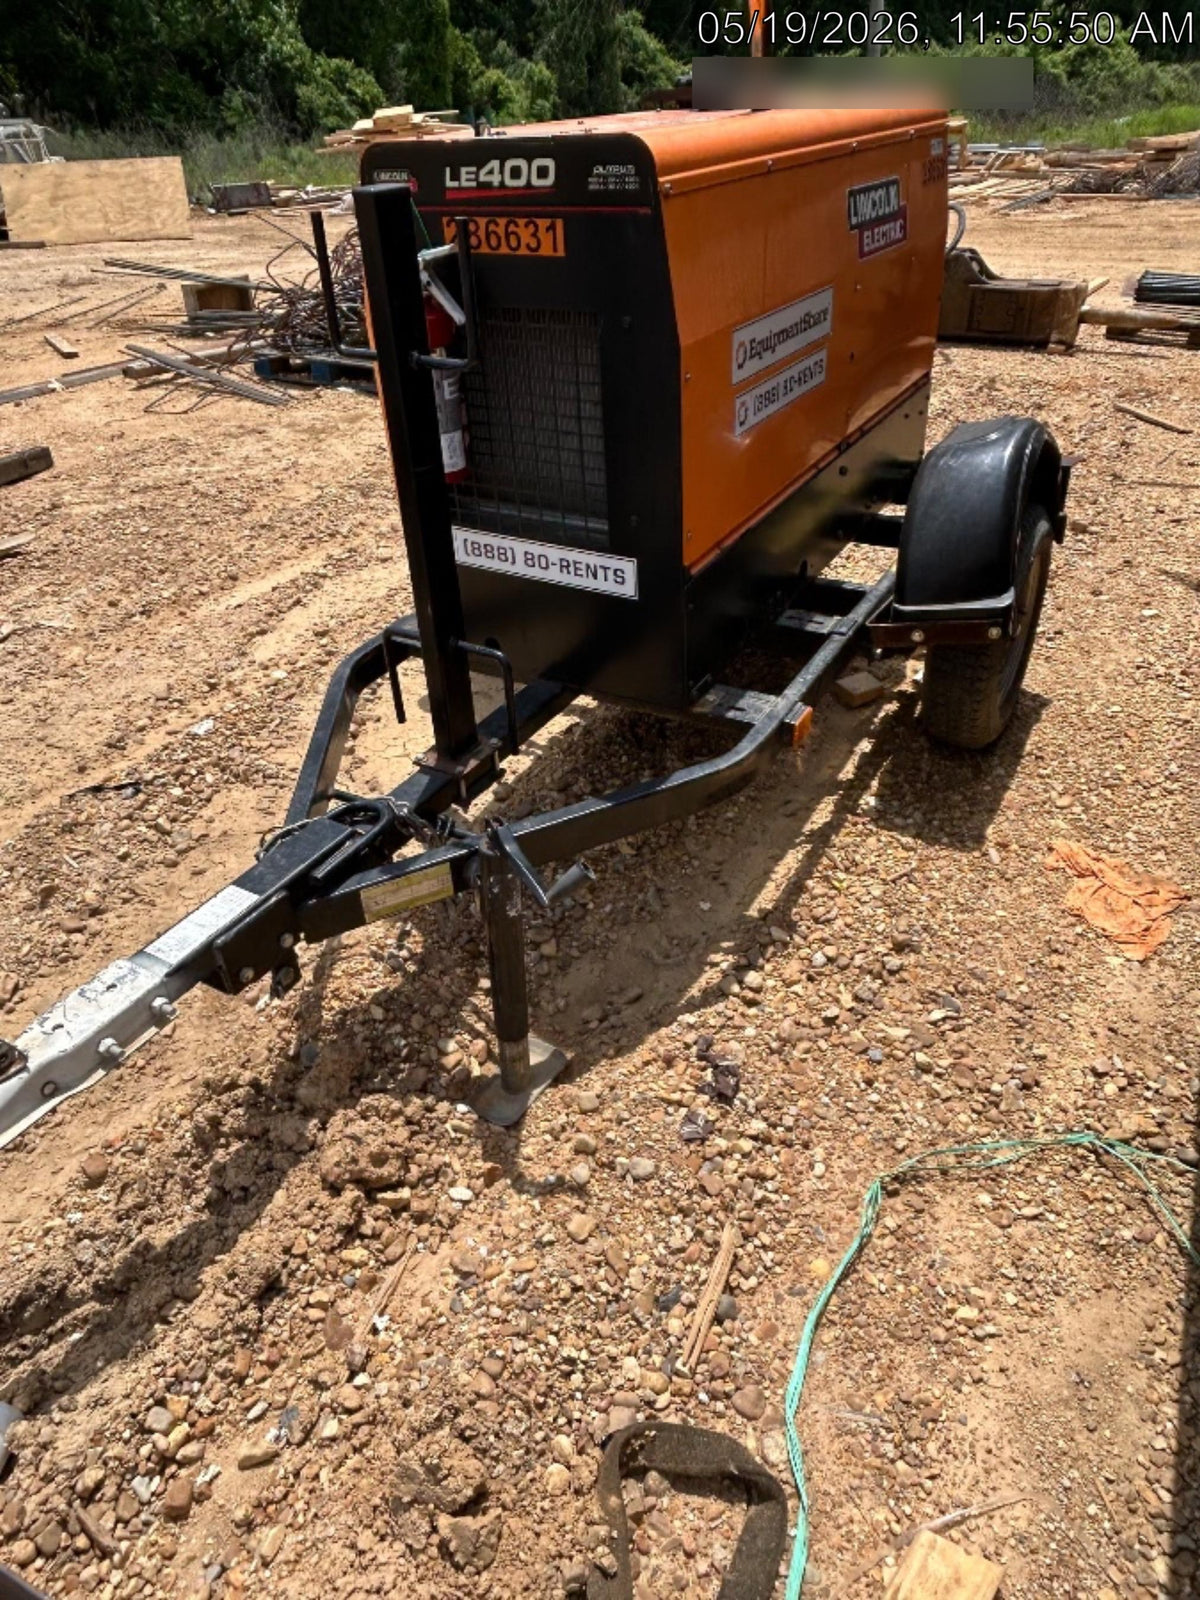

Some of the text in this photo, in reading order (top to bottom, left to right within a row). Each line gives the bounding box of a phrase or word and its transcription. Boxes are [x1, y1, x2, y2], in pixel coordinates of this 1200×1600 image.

[445, 158, 556, 188] LE400
[850, 184, 899, 225] LINCOLN
[863, 219, 905, 252] ELECTRIC
[747, 306, 829, 361] EquipmentShare
[463, 537, 626, 586] (888) 80-RENTS
